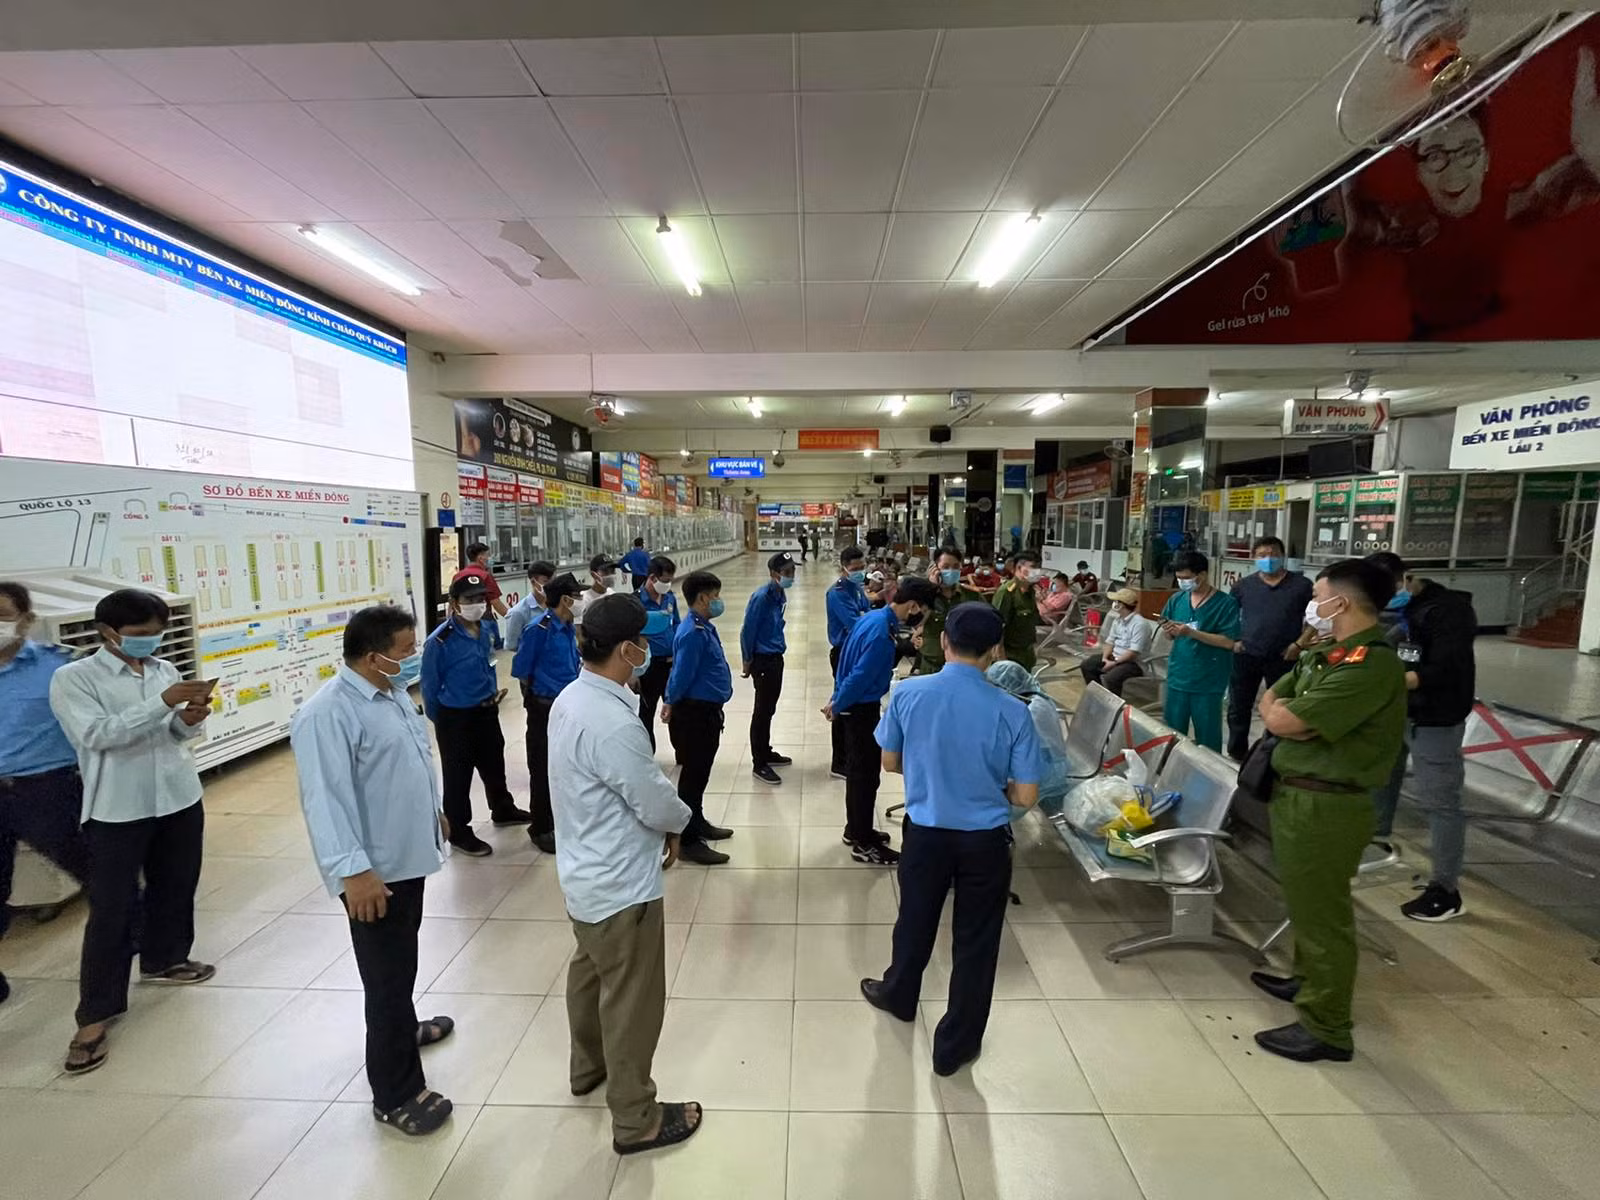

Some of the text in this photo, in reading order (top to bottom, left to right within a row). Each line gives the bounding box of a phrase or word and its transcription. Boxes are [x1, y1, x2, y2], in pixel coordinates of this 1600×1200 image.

[18, 188, 80, 223] CÔNG
[82, 215, 107, 234] TY
[111, 227, 159, 256] TNHH
[161, 248, 194, 269] MTV
[226, 275, 243, 290] XE
[245, 283, 275, 304] MIỀN
[276, 296, 305, 317] ĐÔNG
[307, 309, 331, 328] KÍNH
[331, 321, 356, 337] CHÀO
[1207, 317, 1226, 332] Gel
[1247, 311, 1266, 324] tay
[1480, 395, 1591, 425] VĂN PHÒNG
[1461, 428, 1488, 446] BẾN
[1490, 429, 1511, 442] XE
[1513, 419, 1552, 439] MIỀN
[1535, 442, 1544, 451] 2
[202, 483, 350, 502] SƠ ĐỒ BẾN XE MIỀN ĐÔNG
[19, 499, 54, 511] QUỐC
[78, 498, 92, 506] 13
